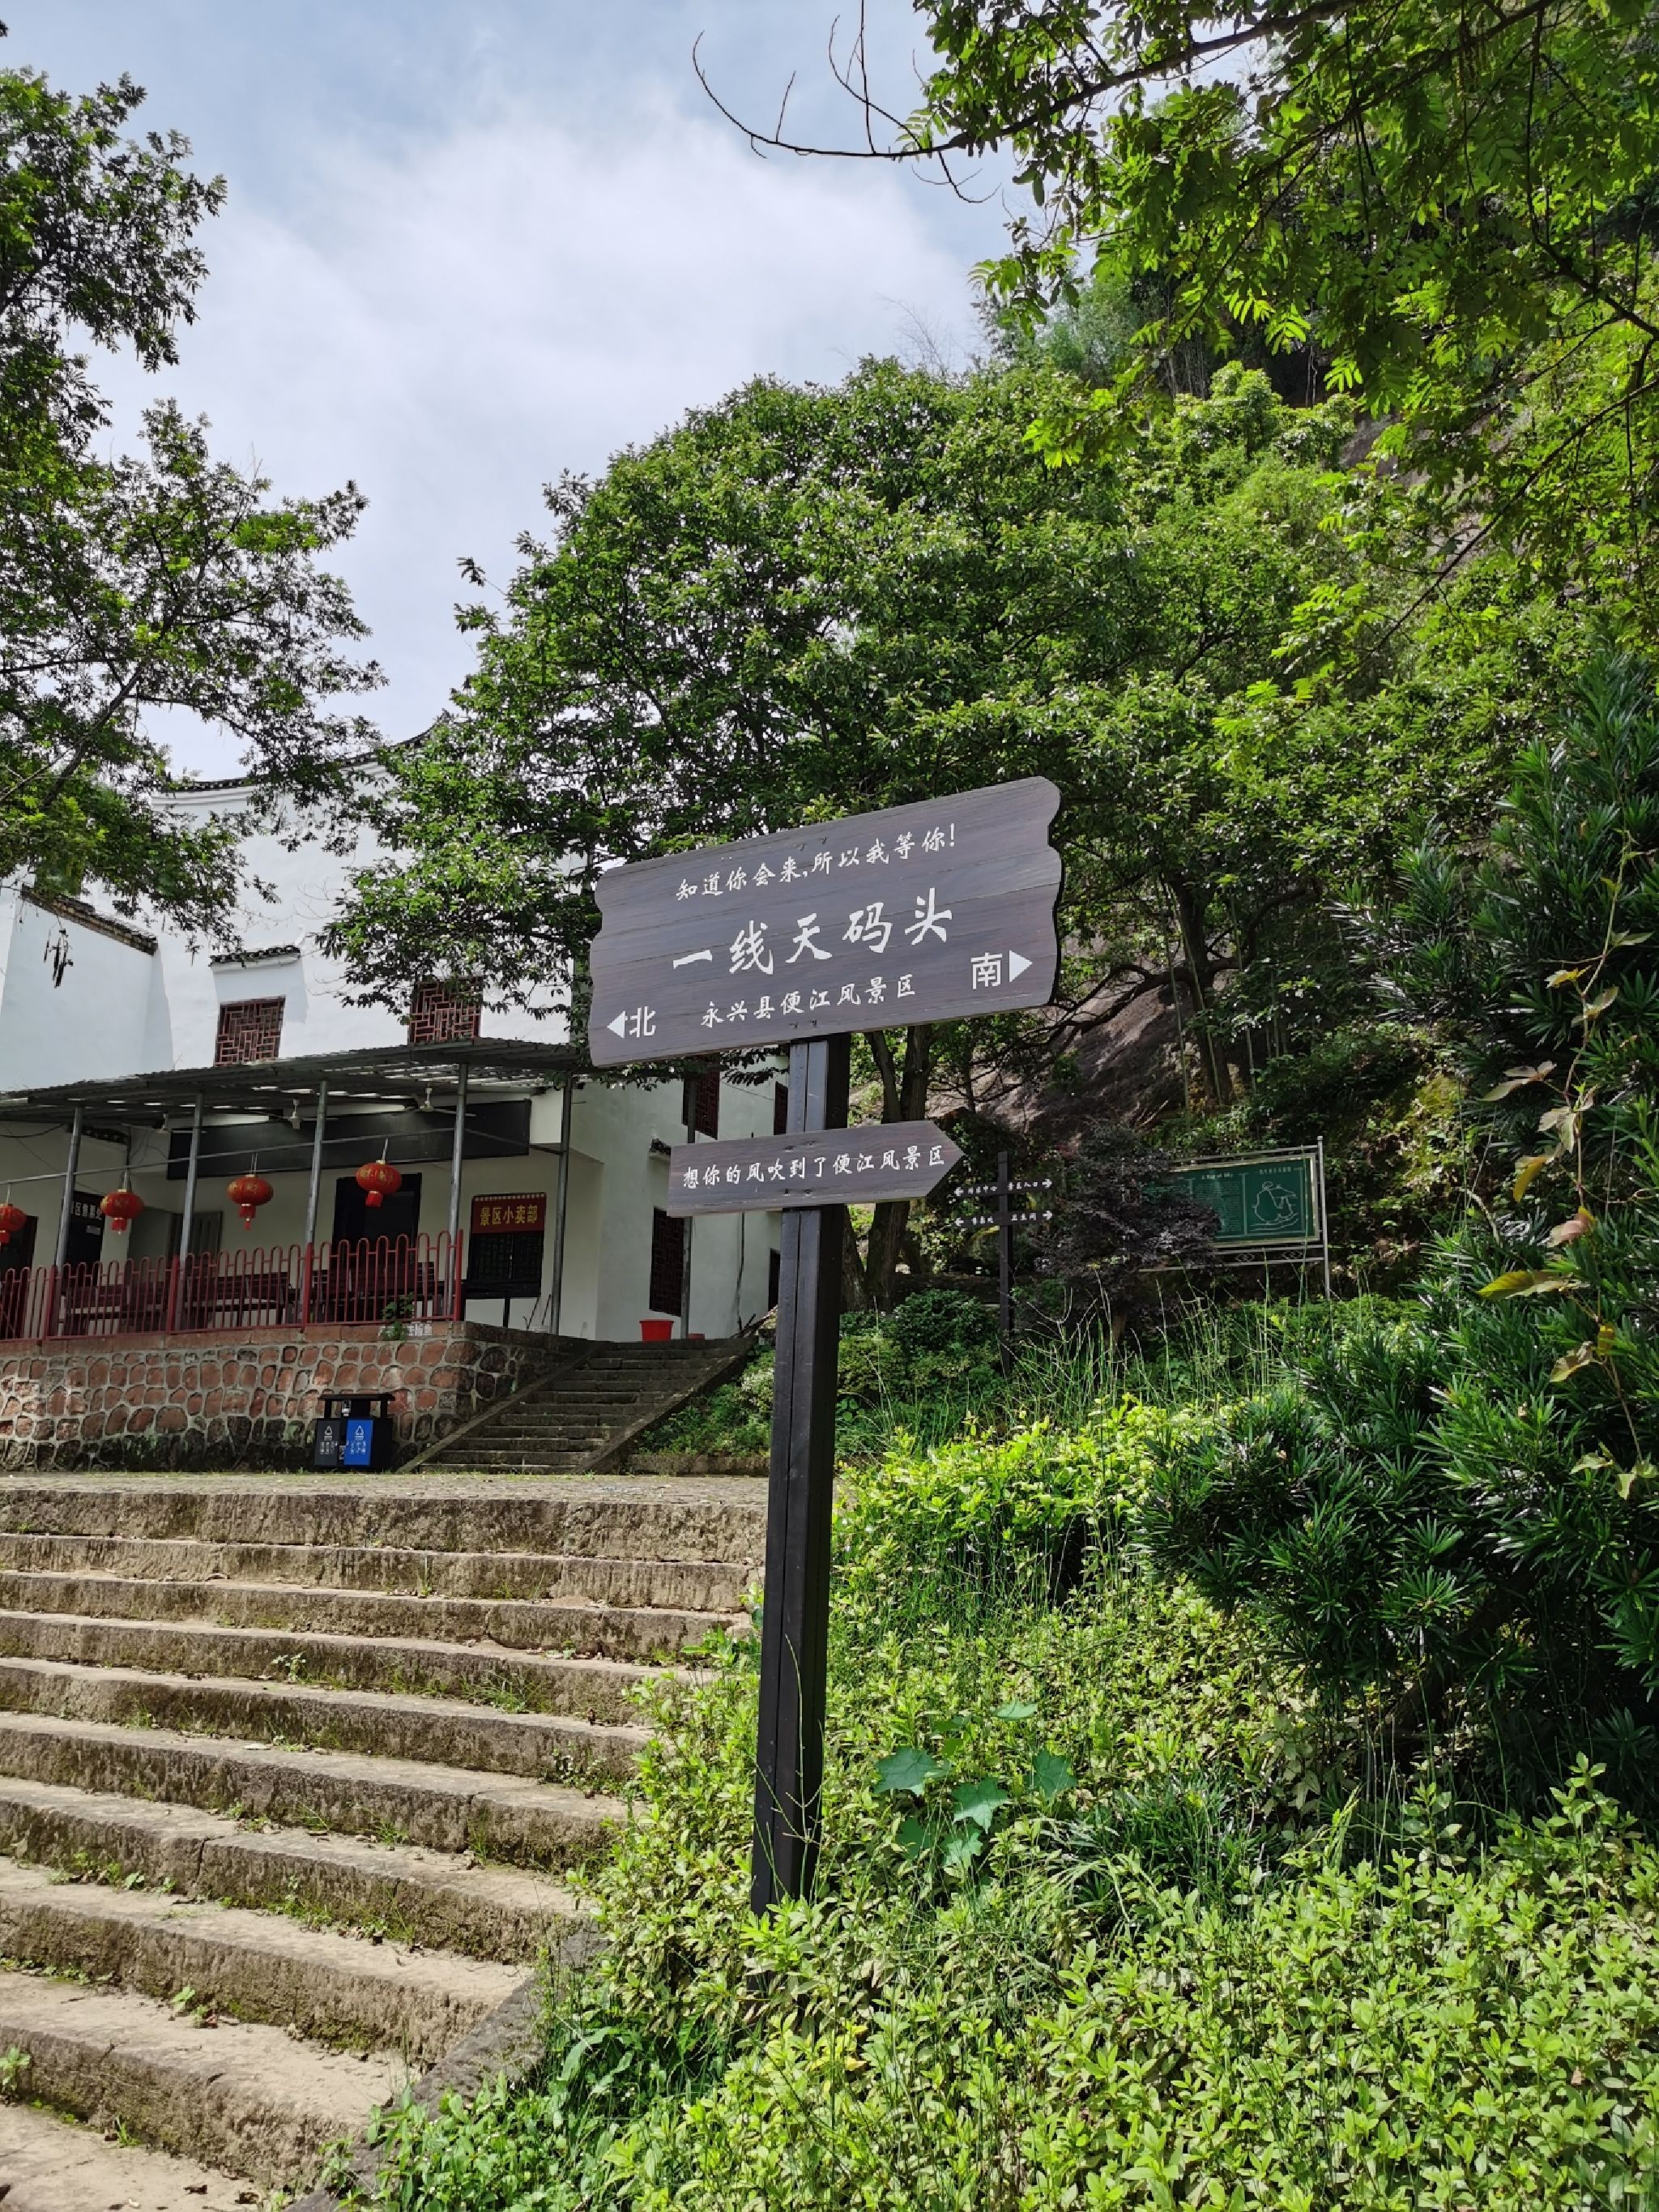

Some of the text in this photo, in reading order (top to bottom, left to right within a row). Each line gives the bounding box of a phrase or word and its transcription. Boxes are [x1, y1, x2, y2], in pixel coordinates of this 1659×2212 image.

[672, 887, 953, 975] 一线天码头
[970, 951, 1002, 989] 南
[700, 973, 916, 1028] 永兴县便江风景区
[628, 1005, 656, 1039] 北
[683, 1145, 945, 1189] 想你的风吹到了便江风景区
[480, 1204, 538, 1226] 景区小卖部
